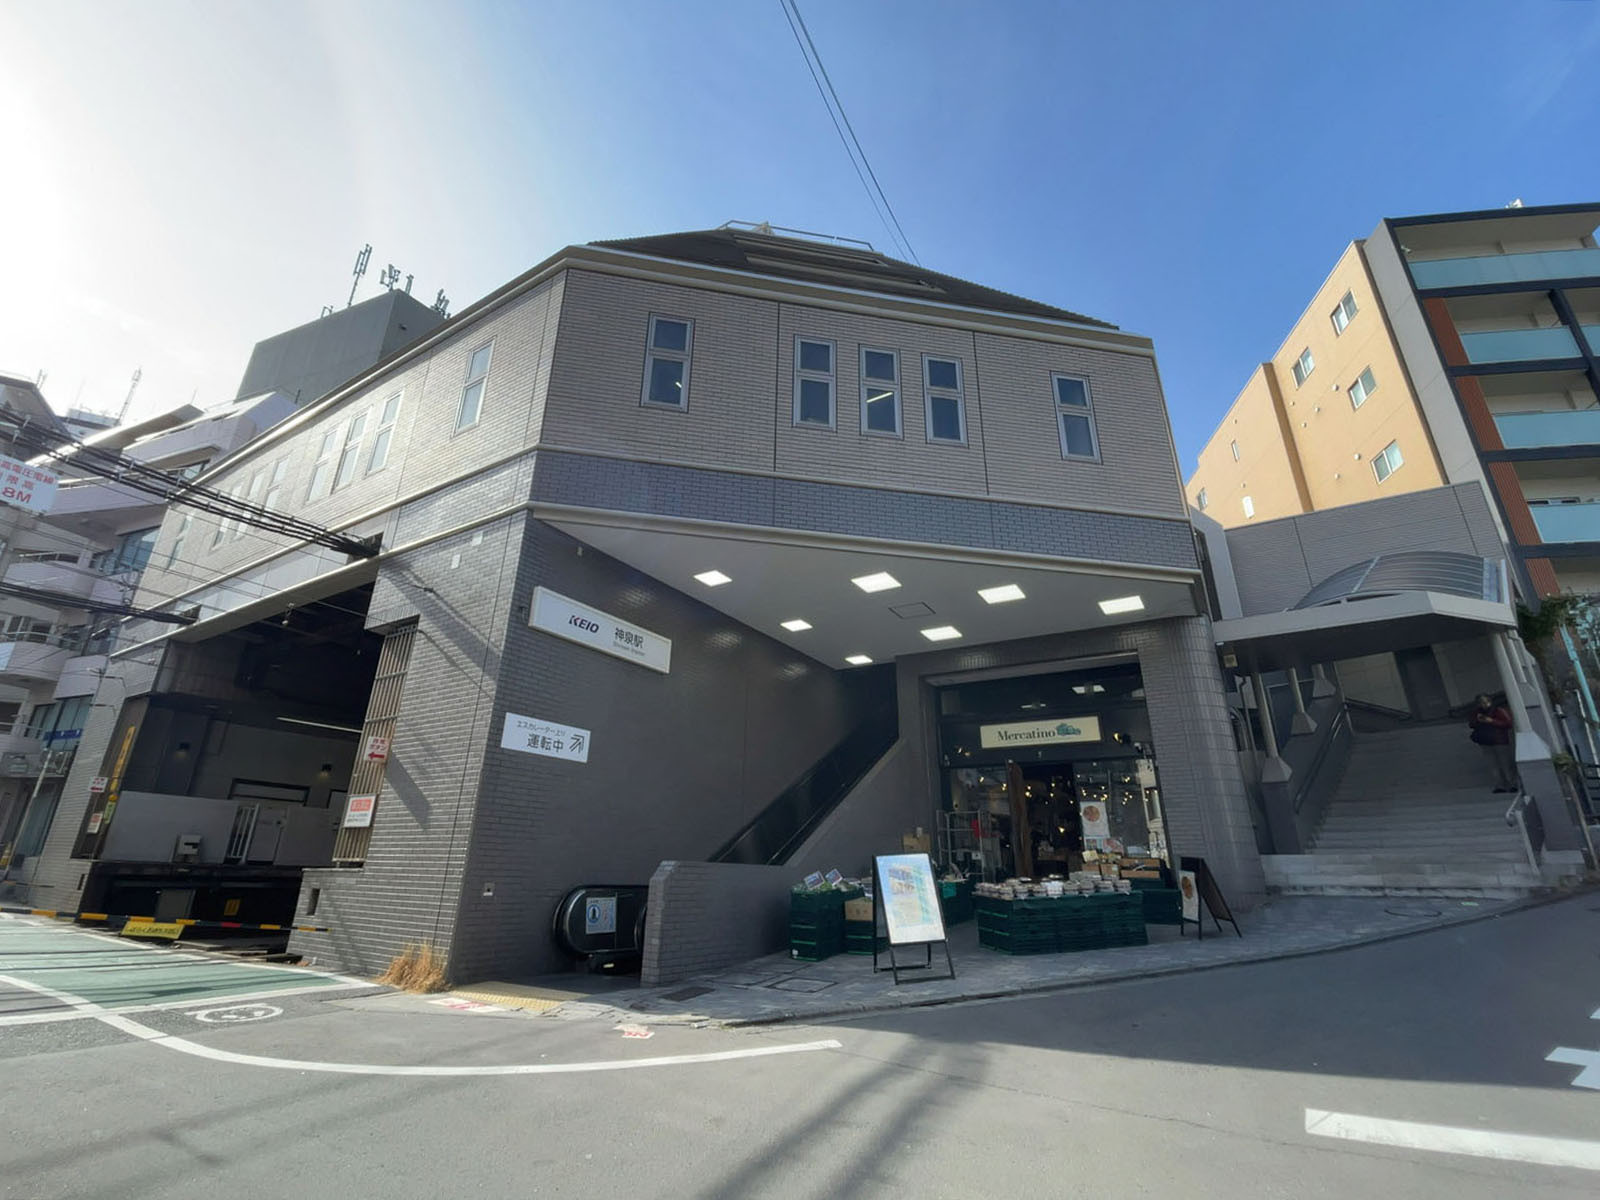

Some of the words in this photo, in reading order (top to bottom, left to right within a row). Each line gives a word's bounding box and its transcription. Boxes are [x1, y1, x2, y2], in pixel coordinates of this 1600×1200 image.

[568, 615, 600, 633] KEIO
[614, 627, 645, 649] 神泉駅
[528, 733, 564, 752] 運転中
[997, 728, 1056, 741] Mercatino
